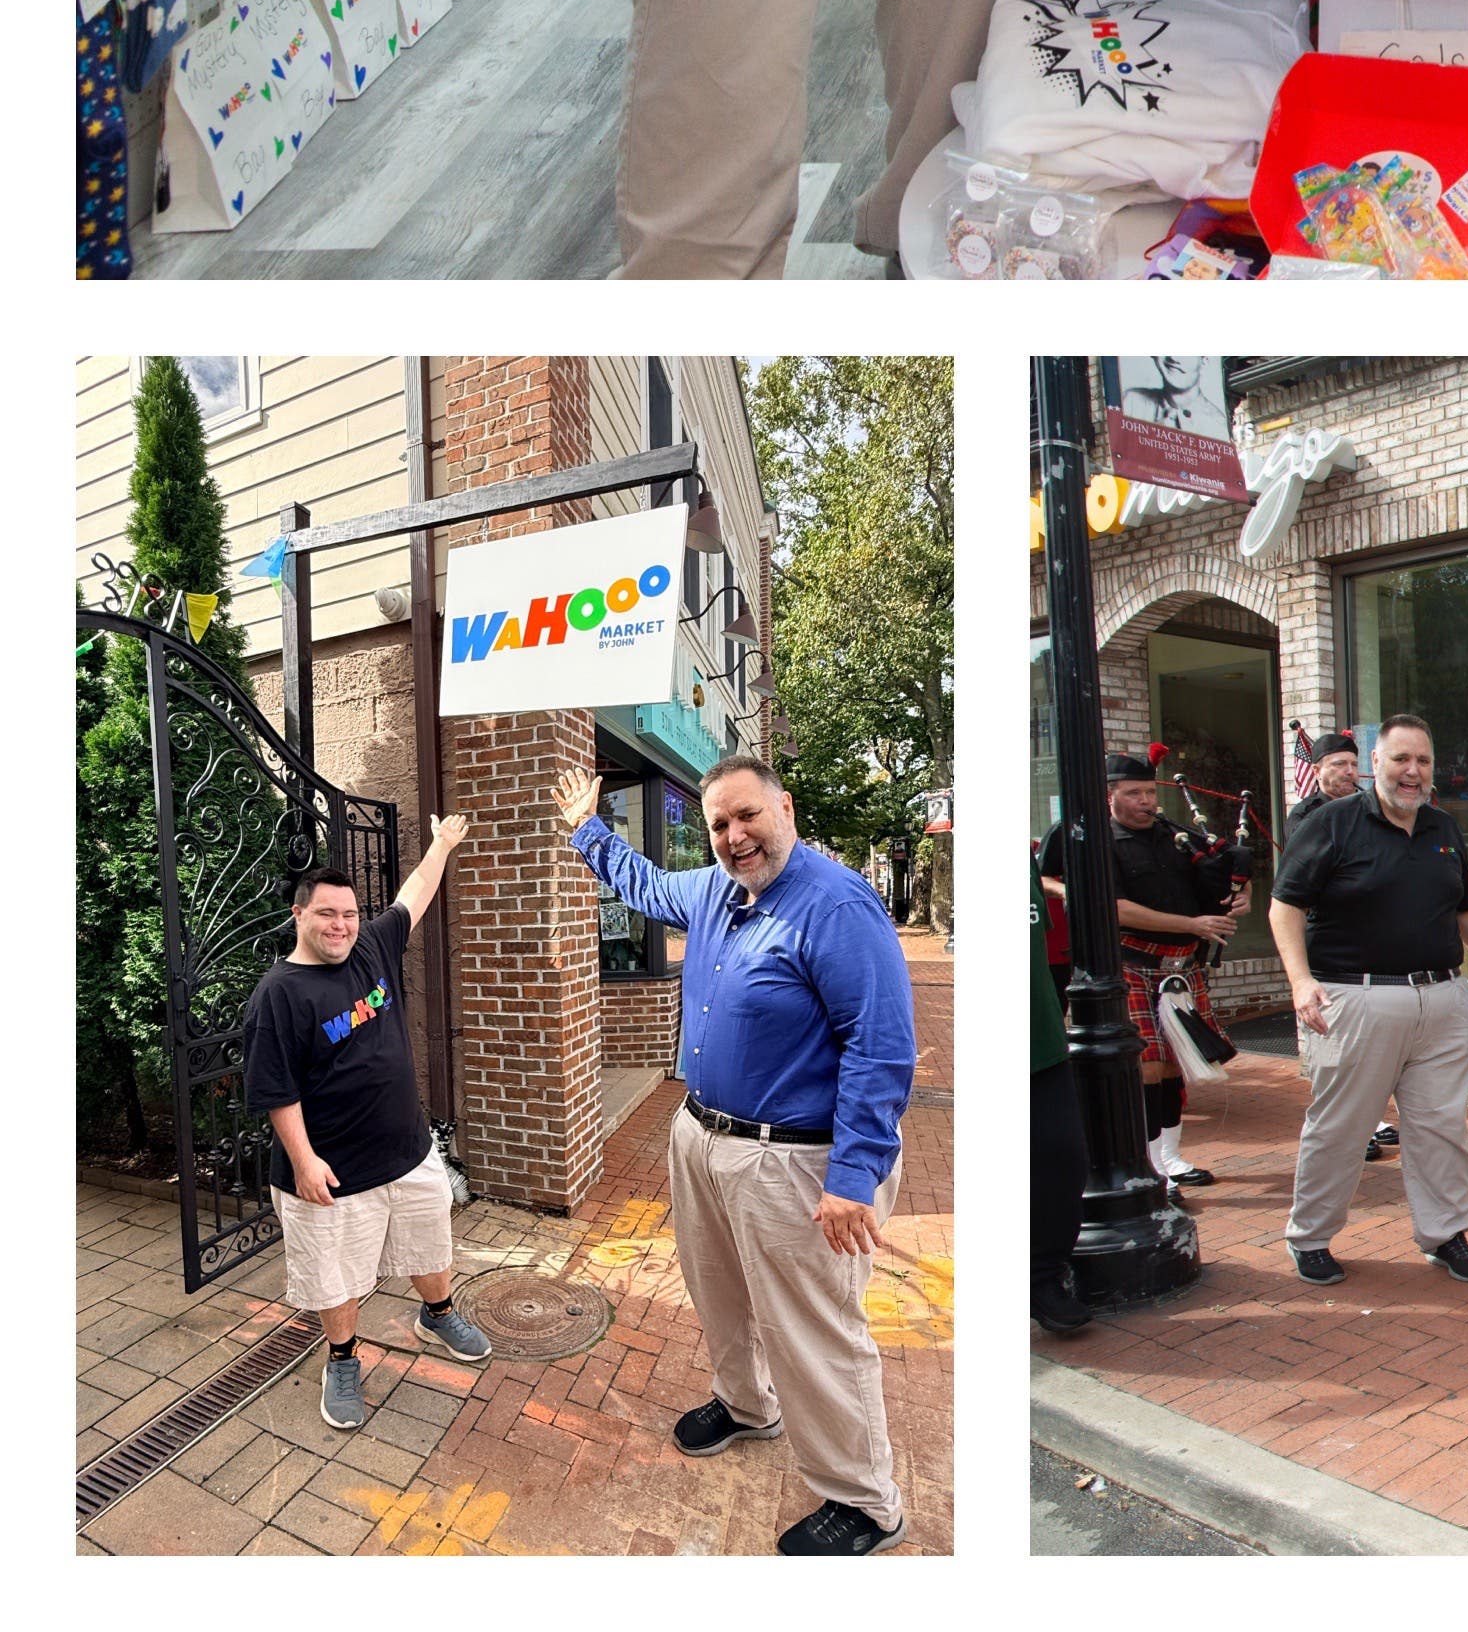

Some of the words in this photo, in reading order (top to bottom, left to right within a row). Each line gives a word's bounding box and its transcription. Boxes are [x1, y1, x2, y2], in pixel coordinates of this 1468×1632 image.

[1120, 419, 1150, 435] JOHN
[1151, 426, 1187, 445] "JACK"
[1189, 436, 1198, 448] F.
[1199, 438, 1235, 457] DWYER
[1138, 435, 1169, 451] UNITED
[1169, 441, 1198, 458] STATES
[1199, 452, 1222, 464] ARMY
[1164, 451, 1199, 467] 1951-1953
[1189, 473, 1226, 490] Kiwanis
[450, 564, 671, 664] WAHOOO
[599, 619, 665, 639] MARKET
[598, 640, 610, 649] BY
[611, 638, 635, 648] JOHN
